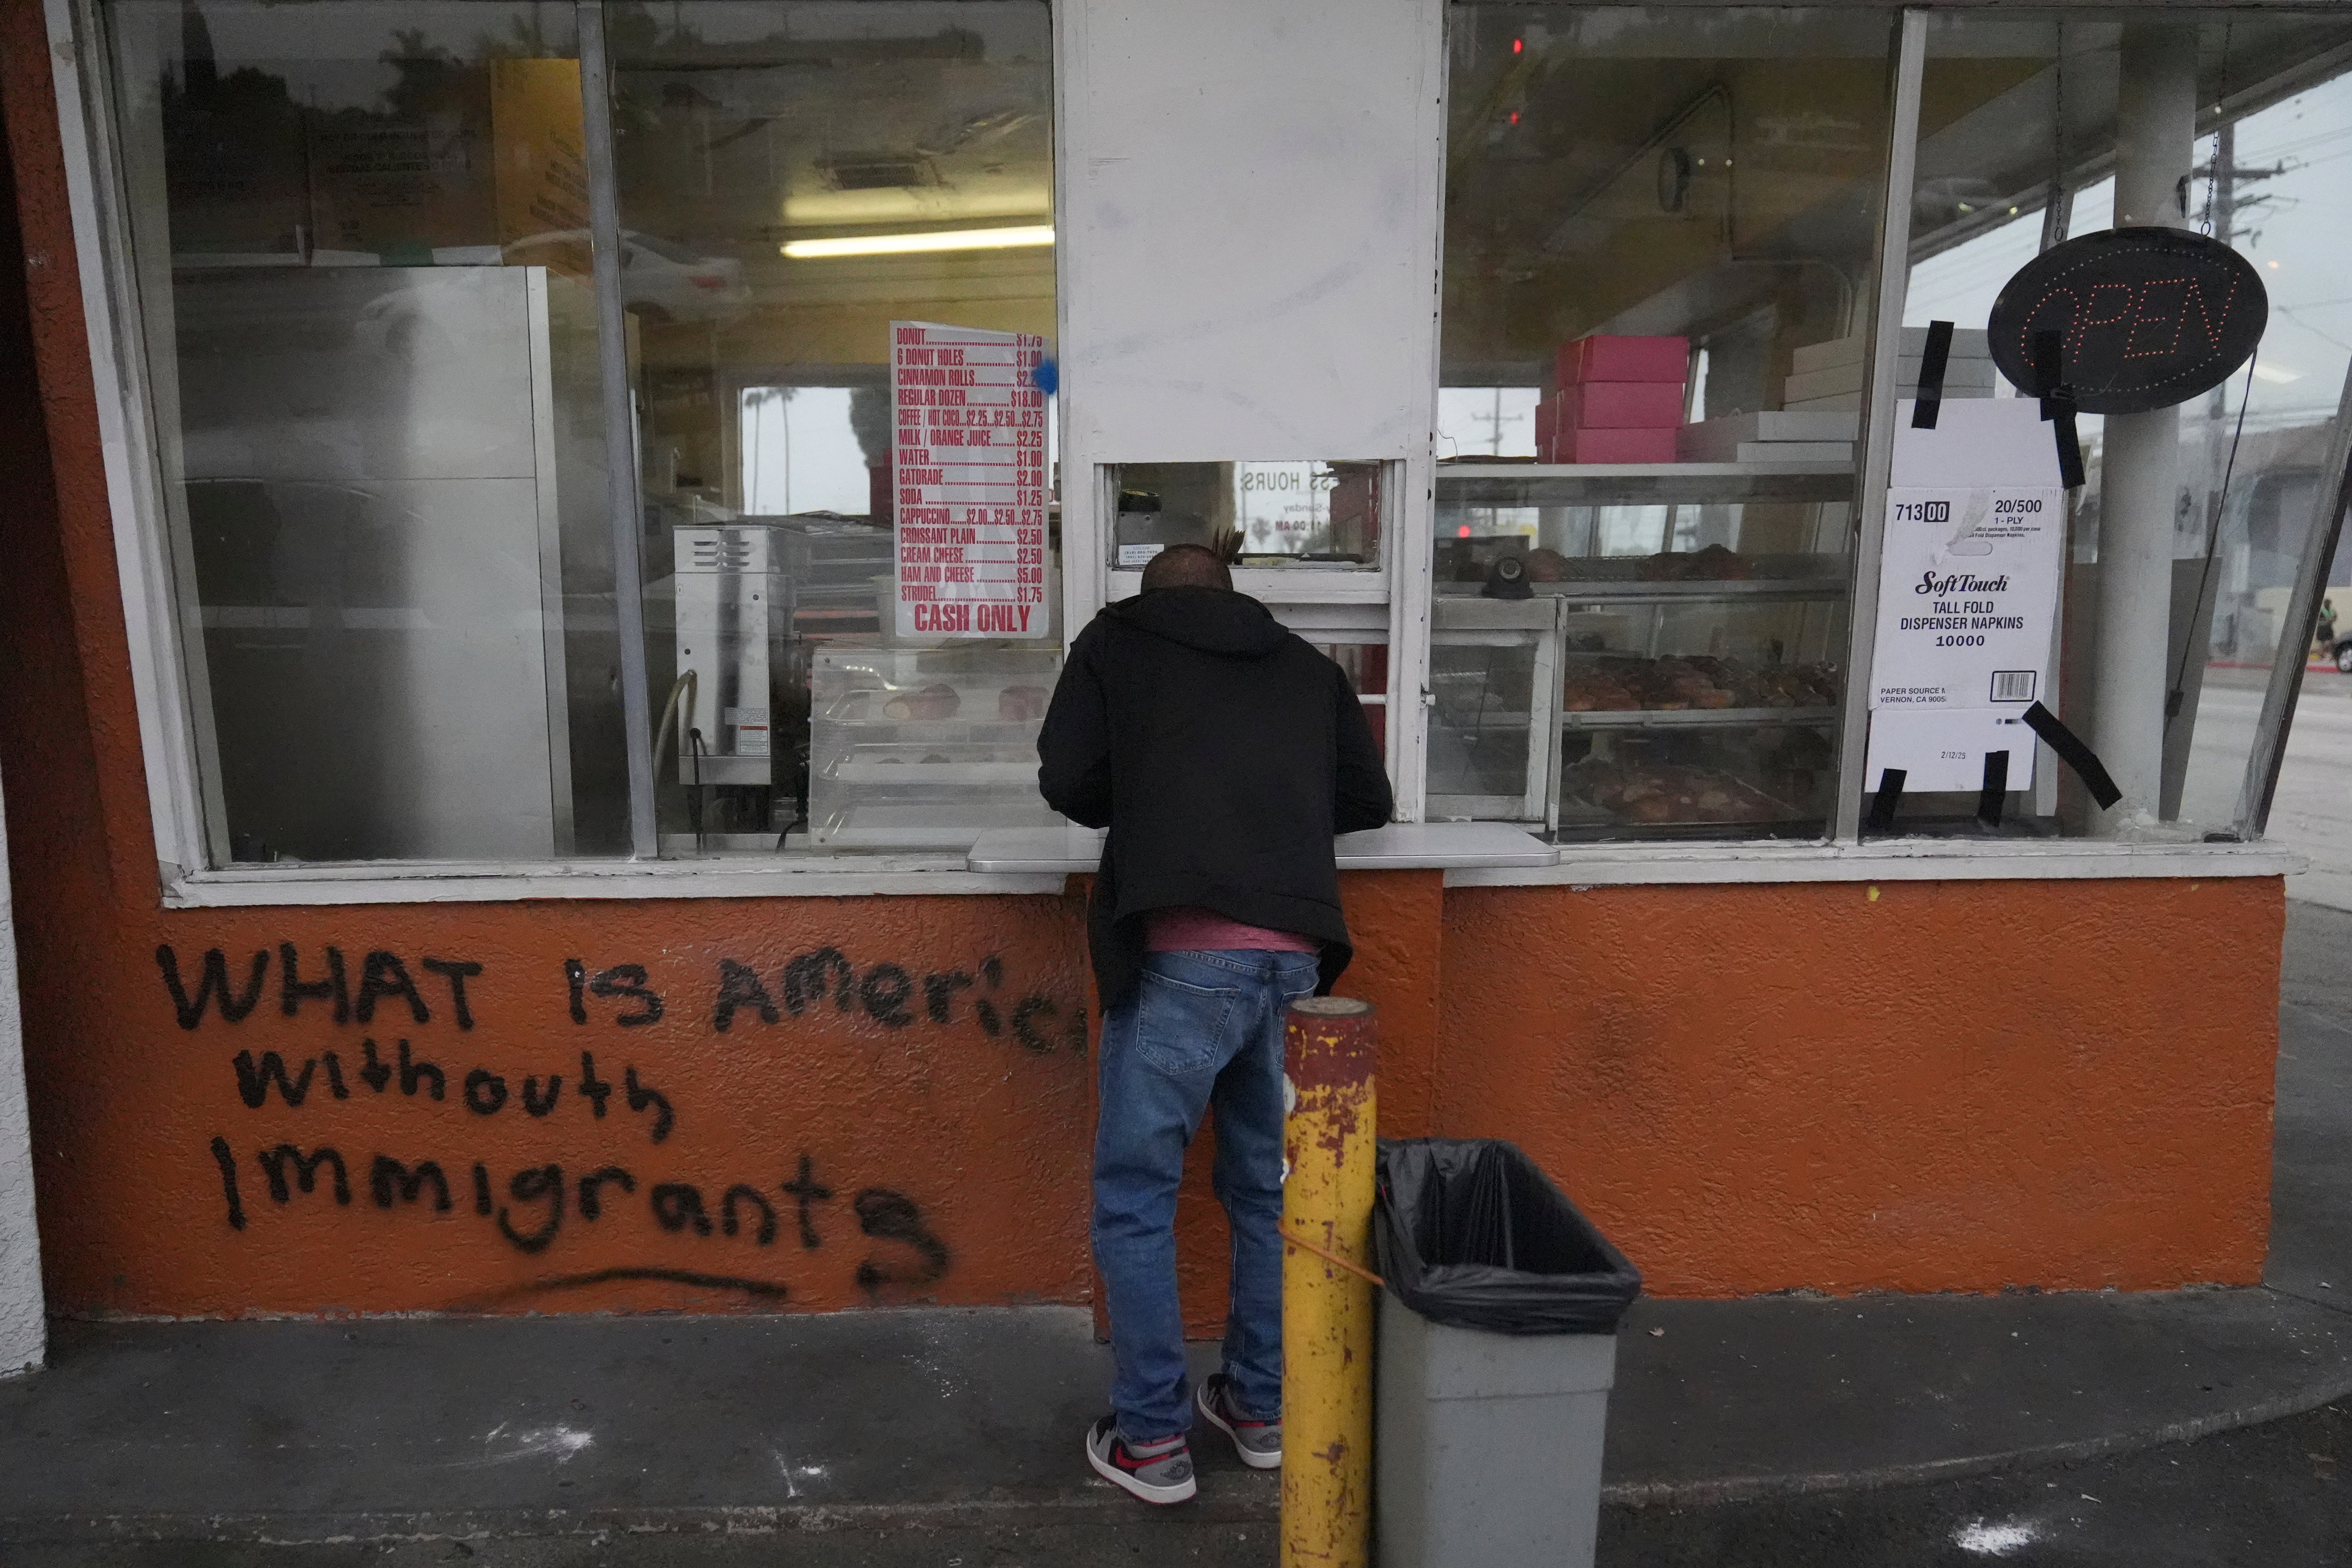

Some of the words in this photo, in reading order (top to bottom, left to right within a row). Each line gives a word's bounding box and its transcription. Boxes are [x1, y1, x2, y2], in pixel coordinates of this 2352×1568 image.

[2021, 272, 2240, 365] OPEN
[897, 328, 925, 345] DONUT
[898, 348, 903, 365] 6
[906, 348, 934, 366] DONUT
[938, 348, 964, 366] HOLES
[1017, 350, 1042, 367] $1.00
[898, 368, 946, 386] CINNAMON
[949, 369, 975, 386] ROLLS
[1017, 370, 1041, 387] $2.2
[898, 389, 936, 405] REGULAR
[939, 390, 965, 406] DOZEN
[1011, 390, 1042, 408] $18.00
[898, 409, 920, 425] COFFEE
[928, 410, 940, 426] HOT
[942, 410, 960, 426] COCO
[899, 429, 920, 445] MILK
[930, 430, 964, 446] ORANGE
[967, 430, 991, 446] JUICE
[1017, 430, 1042, 448] $2.25
[899, 449, 929, 465] WATER
[1017, 450, 1042, 467] $1.00
[900, 469, 943, 485] GATORADE
[1017, 470, 1042, 486] $2.00
[900, 488, 922, 505] SODA
[1017, 489, 1042, 506] $1.25
[1995, 499, 2042, 513] 20/500
[900, 508, 950, 524] CAPPUCCINO
[900, 528, 947, 543] CROISSANT
[951, 528, 975, 544] PLAIN
[1017, 528, 1042, 545] $2.50
[901, 547, 930, 563] CREAM
[934, 547, 964, 563] CHEESE
[1017, 548, 1042, 564] $2.50
[902, 567, 921, 582] HAM
[924, 567, 941, 582] AND
[944, 567, 974, 583] CHEESE
[1017, 567, 1042, 584] $5.00
[902, 586, 937, 601] STRUDEL
[1017, 587, 1042, 603] $1.75
[1933, 602, 1960, 613] TALL
[1964, 602, 1994, 613] FOLD
[915, 604, 969, 631] CASH
[977, 604, 1031, 632] ONLY
[1901, 617, 1967, 630] DISPENSER
[1971, 617, 2024, 629] NAPKINS
[1936, 635, 1984, 646] 10000
[157, 941, 483, 1031] WHAT
[211, 1135, 953, 1290] Immigrants
